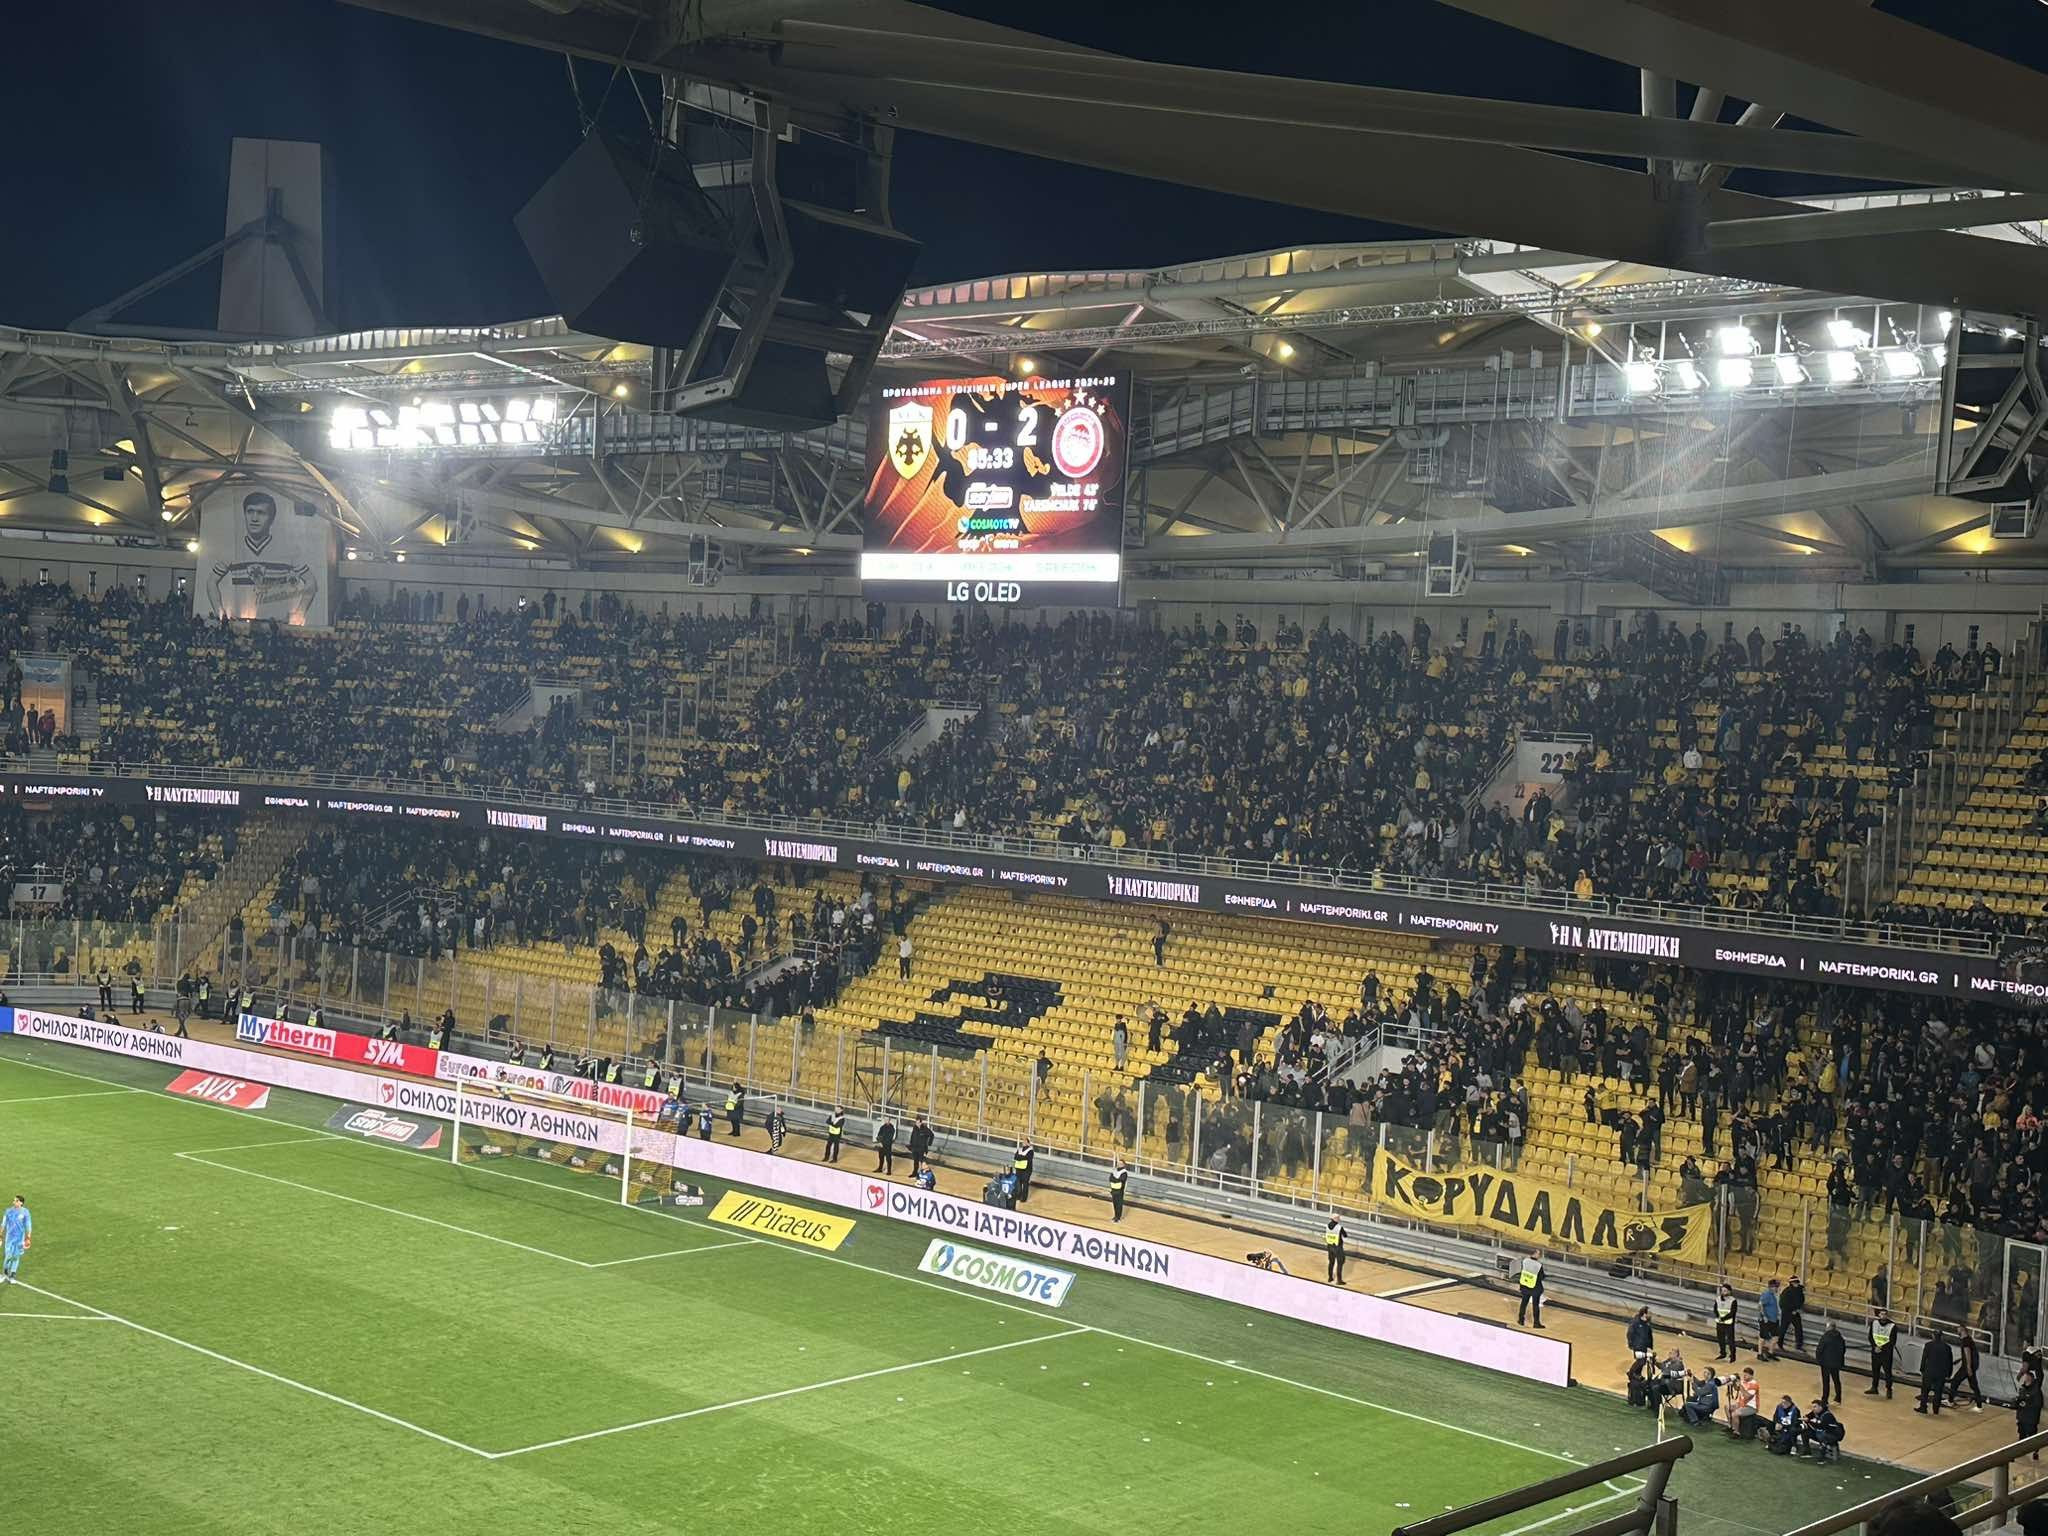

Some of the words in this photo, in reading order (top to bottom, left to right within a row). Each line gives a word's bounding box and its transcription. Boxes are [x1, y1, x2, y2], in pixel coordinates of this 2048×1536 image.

[947, 408, 967, 451] 0
[1016, 407, 1038, 446] 2
[947, 582, 969, 601] LG
[975, 582, 1021, 602] OLED
[91, 787, 104, 797] TV
[30, 885, 47, 900] 17
[1056, 876, 1068, 887] TV
[1485, 924, 1499, 934] TV
[1715, 949, 1786, 968] ΕΦΗΜΕΡΙΔΑ
[1971, 977, 2048, 997] NAFTEMPO
[32, 1016, 78, 1039] ΟΜΙΛΟΣ
[80, 1026, 130, 1051] ΙΑΤΡΙΚΟΥ
[131, 1036, 182, 1059] ΑΘΗΝΩΝ
[240, 1015, 332, 1051] Mytherm
[363, 1039, 405, 1067] SYM
[193, 1082, 246, 1101] AVIS
[400, 1087, 456, 1114] ΟΜΙΛΟΣ
[460, 1101, 527, 1132] ΙΑΤΡΙΚΟΥ
[530, 1112, 599, 1144] ΑΘΗΝΩΝ
[751, 1204, 832, 1243] Piraeus
[892, 1192, 969, 1228] ΟΜΙΛΟΣ
[974, 1213, 1067, 1252] ΙΑΤΡΙΚΟΥ
[1070, 1235, 1170, 1278] ΑΘΗΝΩΝ
[951, 1253, 1060, 1301] COSMOTE
